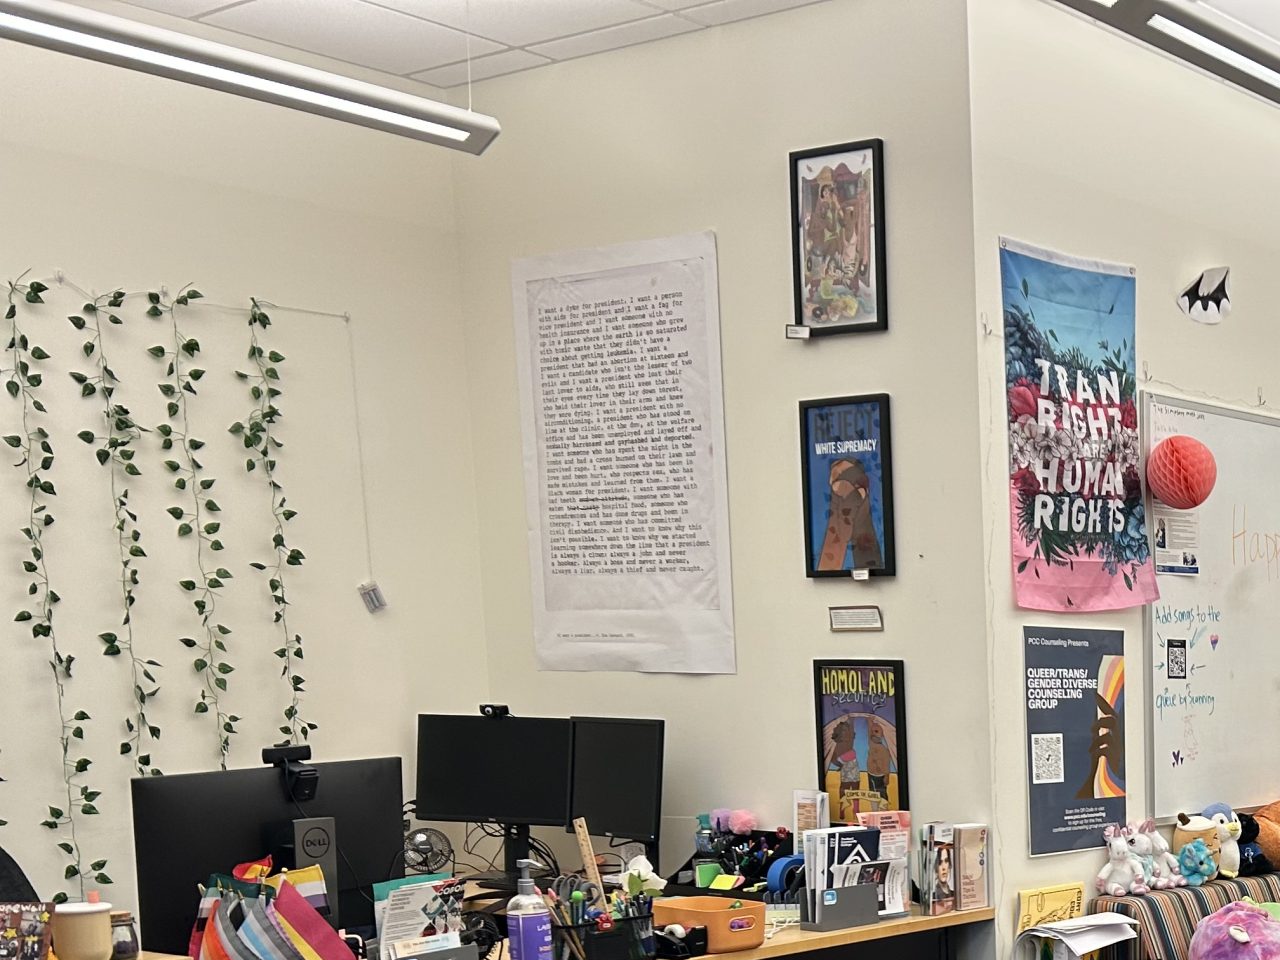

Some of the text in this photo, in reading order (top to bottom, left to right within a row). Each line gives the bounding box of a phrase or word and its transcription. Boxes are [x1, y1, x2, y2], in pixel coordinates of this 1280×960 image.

[815, 438, 877, 455] WHITE SUPREMACY
[1034, 458, 1125, 497] HUMAN
[1034, 494, 1126, 533] RIGHTS
[1155, 606, 1172, 624] Add
[1174, 608, 1194, 630] songs
[1207, 607, 1221, 622] the
[1028, 637, 1089, 647] PCC Counseling Presents
[1027, 668, 1088, 678] QUEER/TRANS/
[1027, 679, 1098, 688] GENDER DIVERSE
[1028, 689, 1083, 698] COUNSELING
[1028, 699, 1058, 709] GROUP
